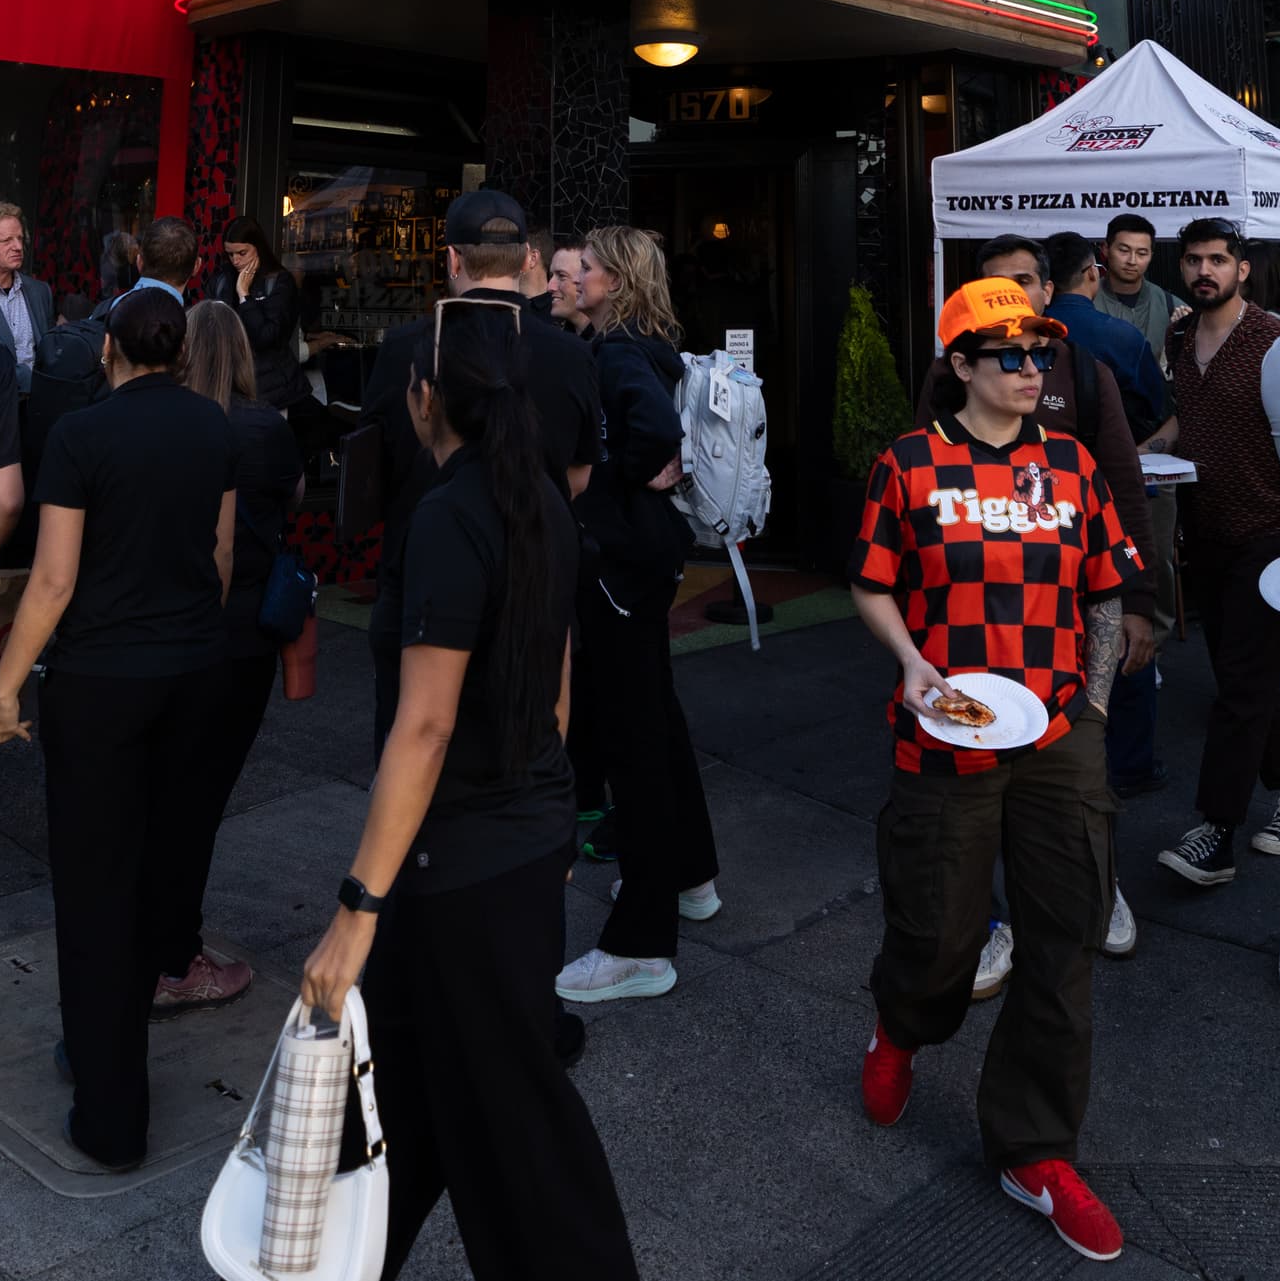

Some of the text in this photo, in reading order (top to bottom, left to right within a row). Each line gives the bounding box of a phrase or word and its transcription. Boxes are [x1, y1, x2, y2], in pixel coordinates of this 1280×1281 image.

[666, 88, 751, 122] 1570
[1079, 127, 1150, 141] TONY'S
[1076, 138, 1140, 150] PIZZA
[946, 190, 1230, 211] TONY'S PIZZA NAPOLETANA
